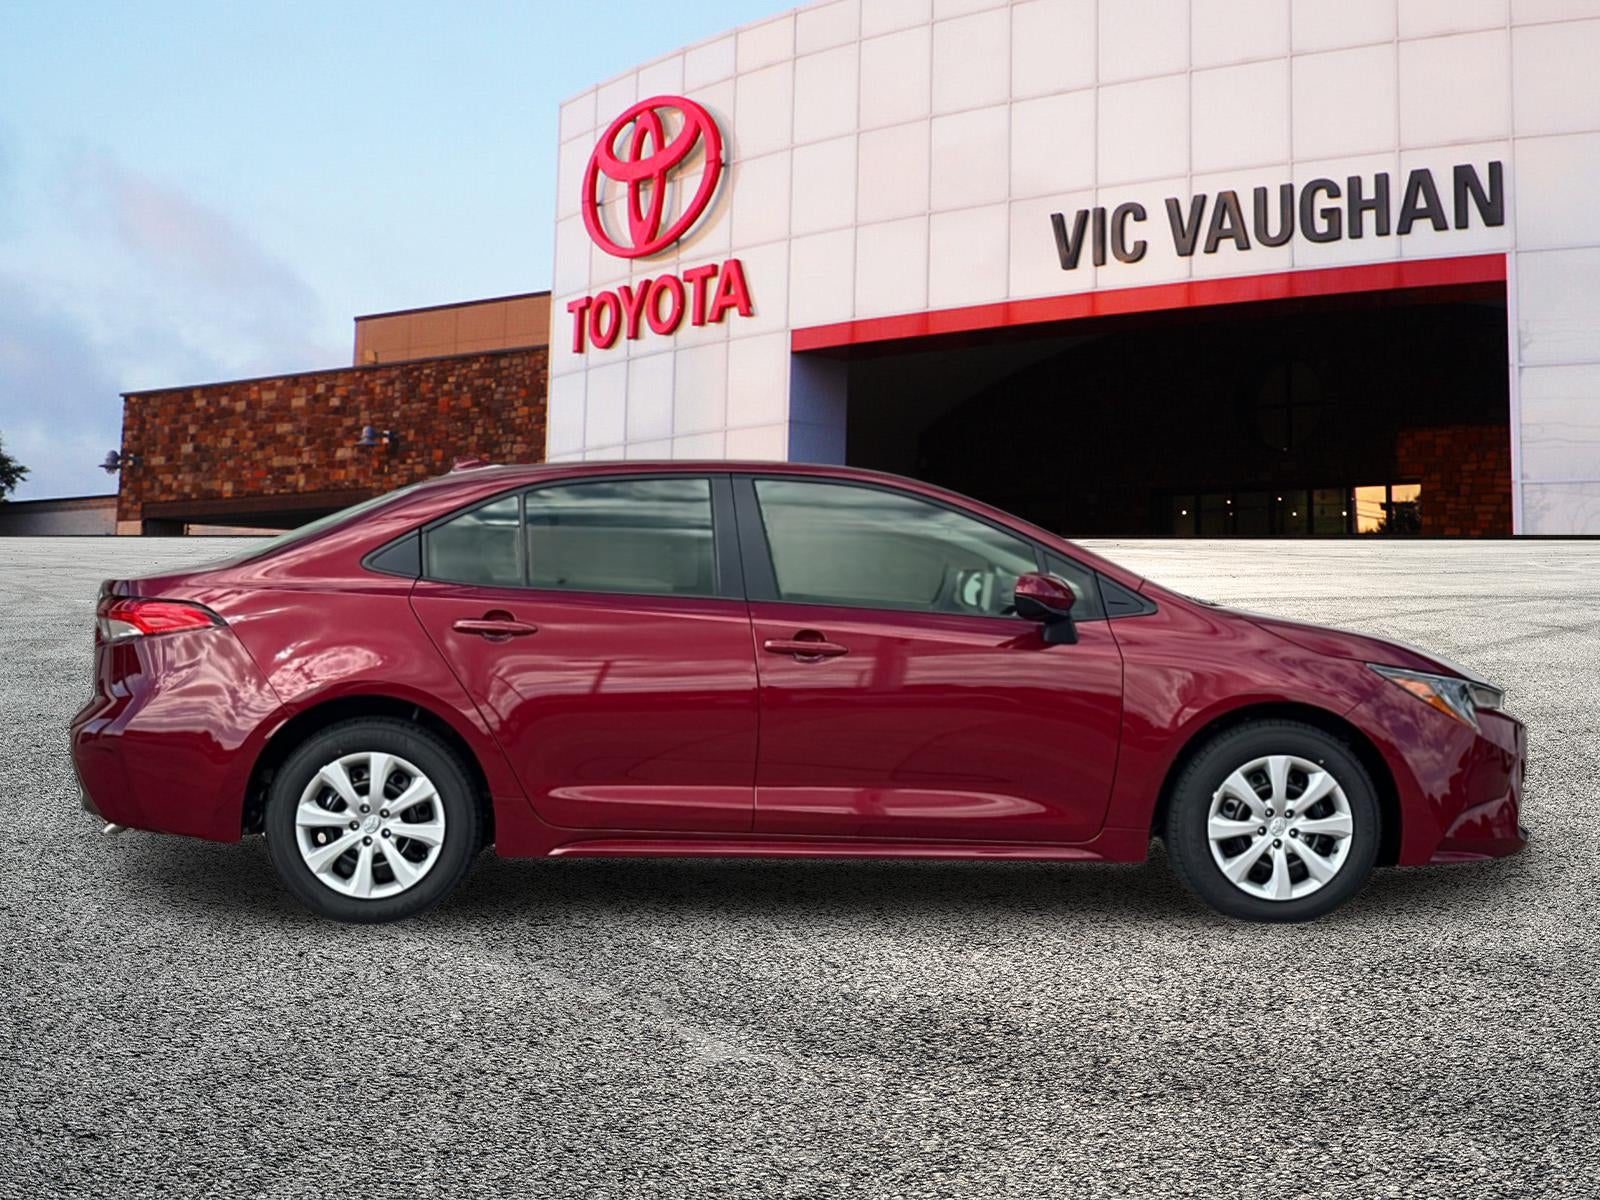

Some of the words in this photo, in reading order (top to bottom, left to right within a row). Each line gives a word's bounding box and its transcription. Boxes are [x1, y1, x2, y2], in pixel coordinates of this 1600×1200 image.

[1050, 201, 1147, 270] VIC
[1165, 161, 1505, 257] VAUGHAN
[567, 259, 754, 353] TOYOTA
